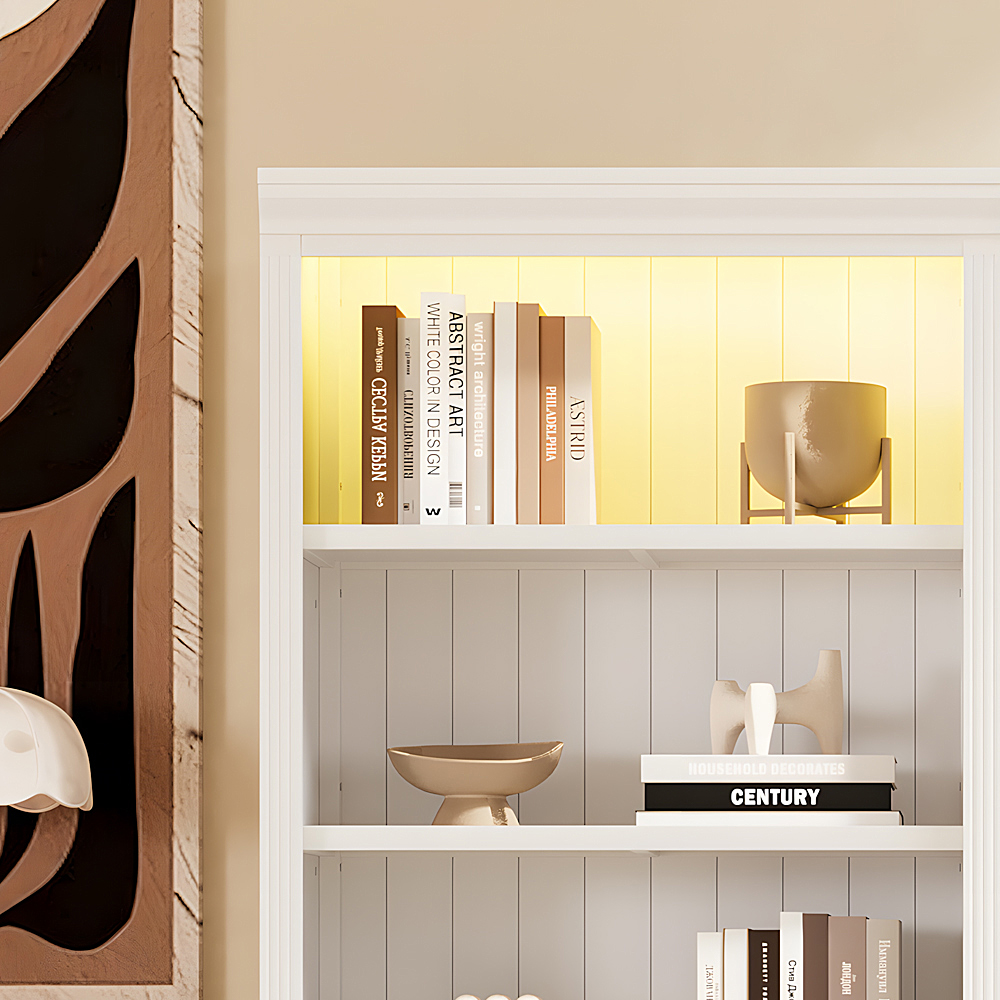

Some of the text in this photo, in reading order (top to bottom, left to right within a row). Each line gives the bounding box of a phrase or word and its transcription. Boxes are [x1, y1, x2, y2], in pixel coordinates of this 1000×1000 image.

[426, 302, 441, 476] WHITE COLOR IN DESIGN
[449, 311, 463, 437] ABSTRACT ART
[471, 321, 486, 458] wright architecture
[545, 385, 557, 462] PHILADELPHIA
[569, 396, 586, 461] ÆSTRID
[688, 762, 846, 775] HOUSEHOLD DECORATES
[730, 788, 821, 806] CENTURY
[787, 960, 796, 982] Стив
[876, 939, 890, 993] Иммануил
